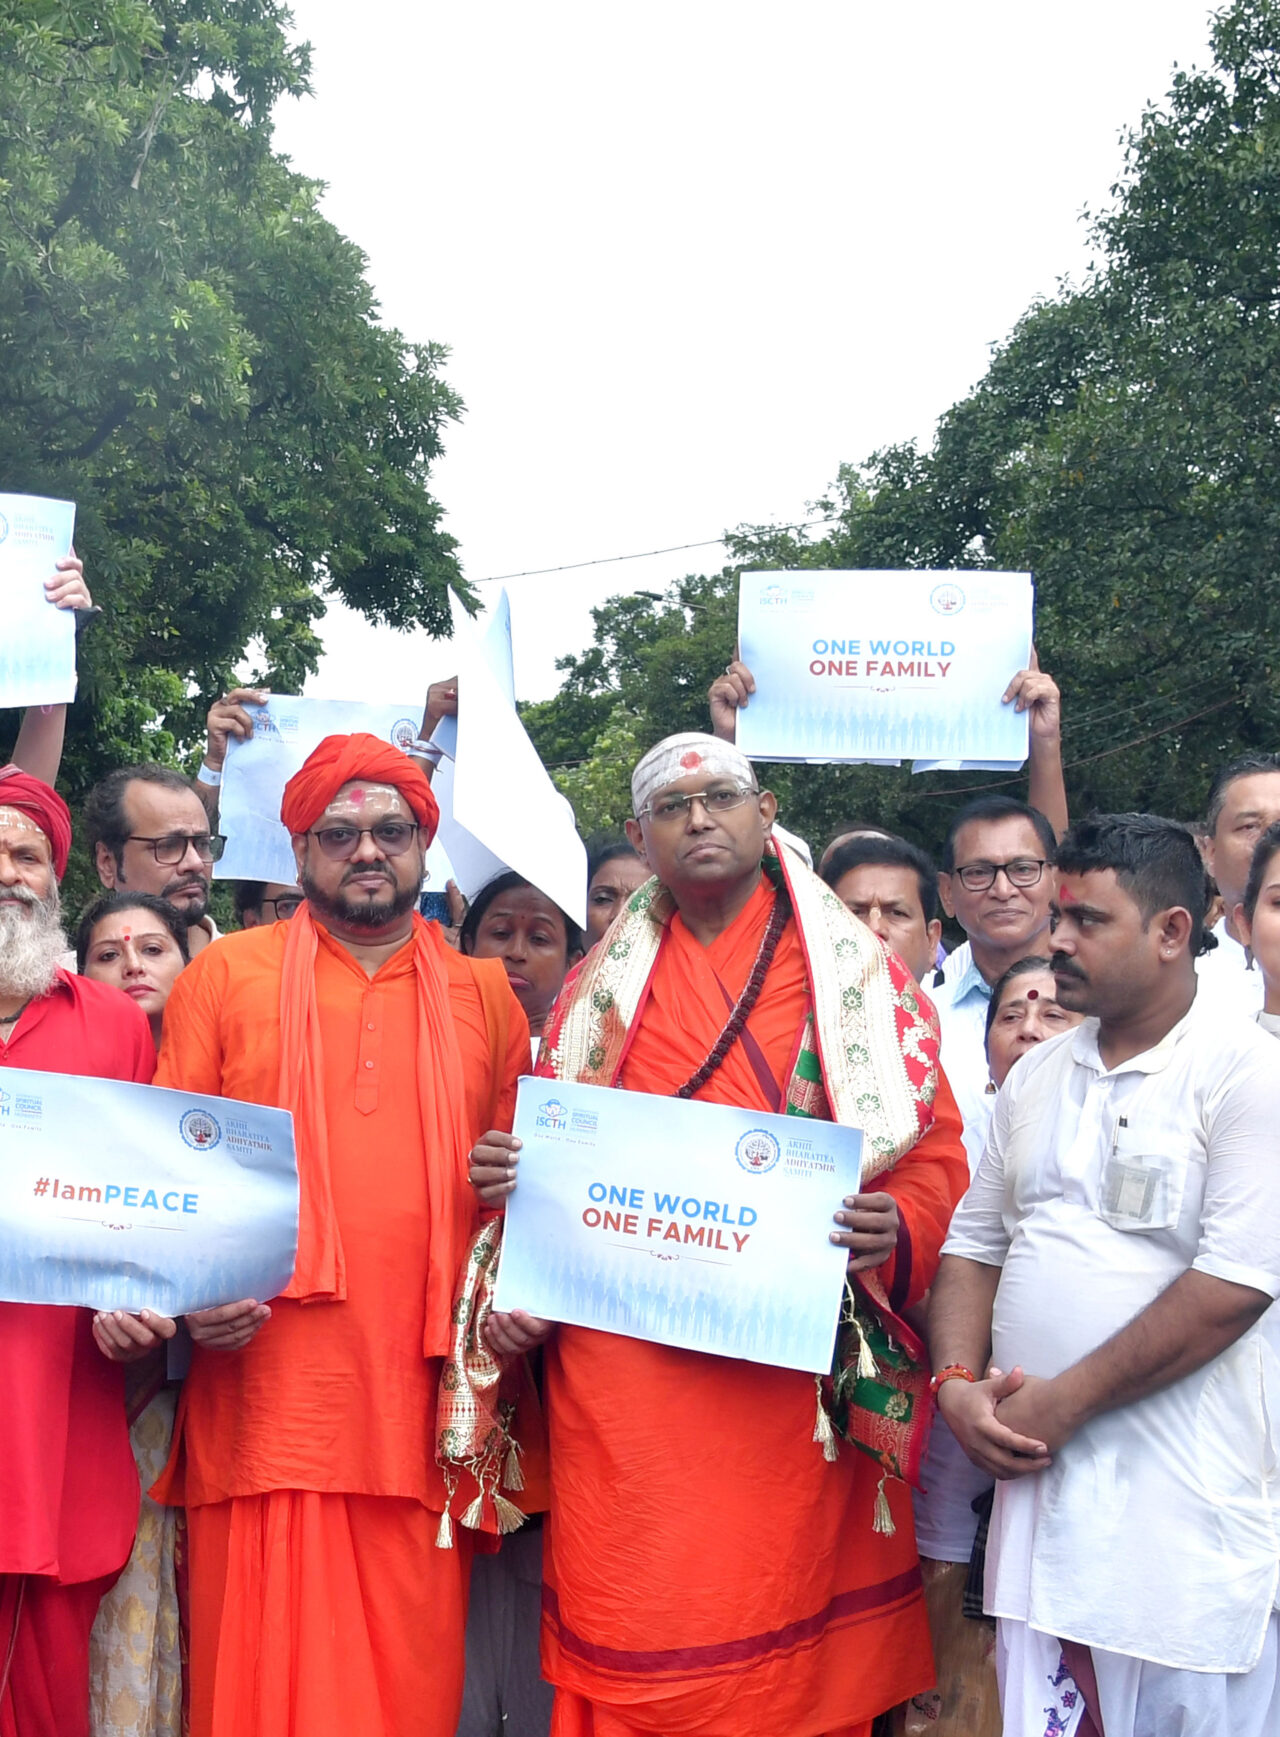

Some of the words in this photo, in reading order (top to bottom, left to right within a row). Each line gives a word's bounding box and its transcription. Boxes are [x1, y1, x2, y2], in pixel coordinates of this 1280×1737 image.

[812, 639, 860, 655] ONE
[869, 640, 955, 657] WORLD
[809, 660, 858, 676] ONE
[866, 660, 951, 677] FAMILY
[33, 1176, 199, 1214] #IamPEACE
[588, 1182, 644, 1209] ONE
[654, 1192, 758, 1227] WORLD
[582, 1207, 639, 1235] ONE
[646, 1218, 750, 1252] FAMILY
